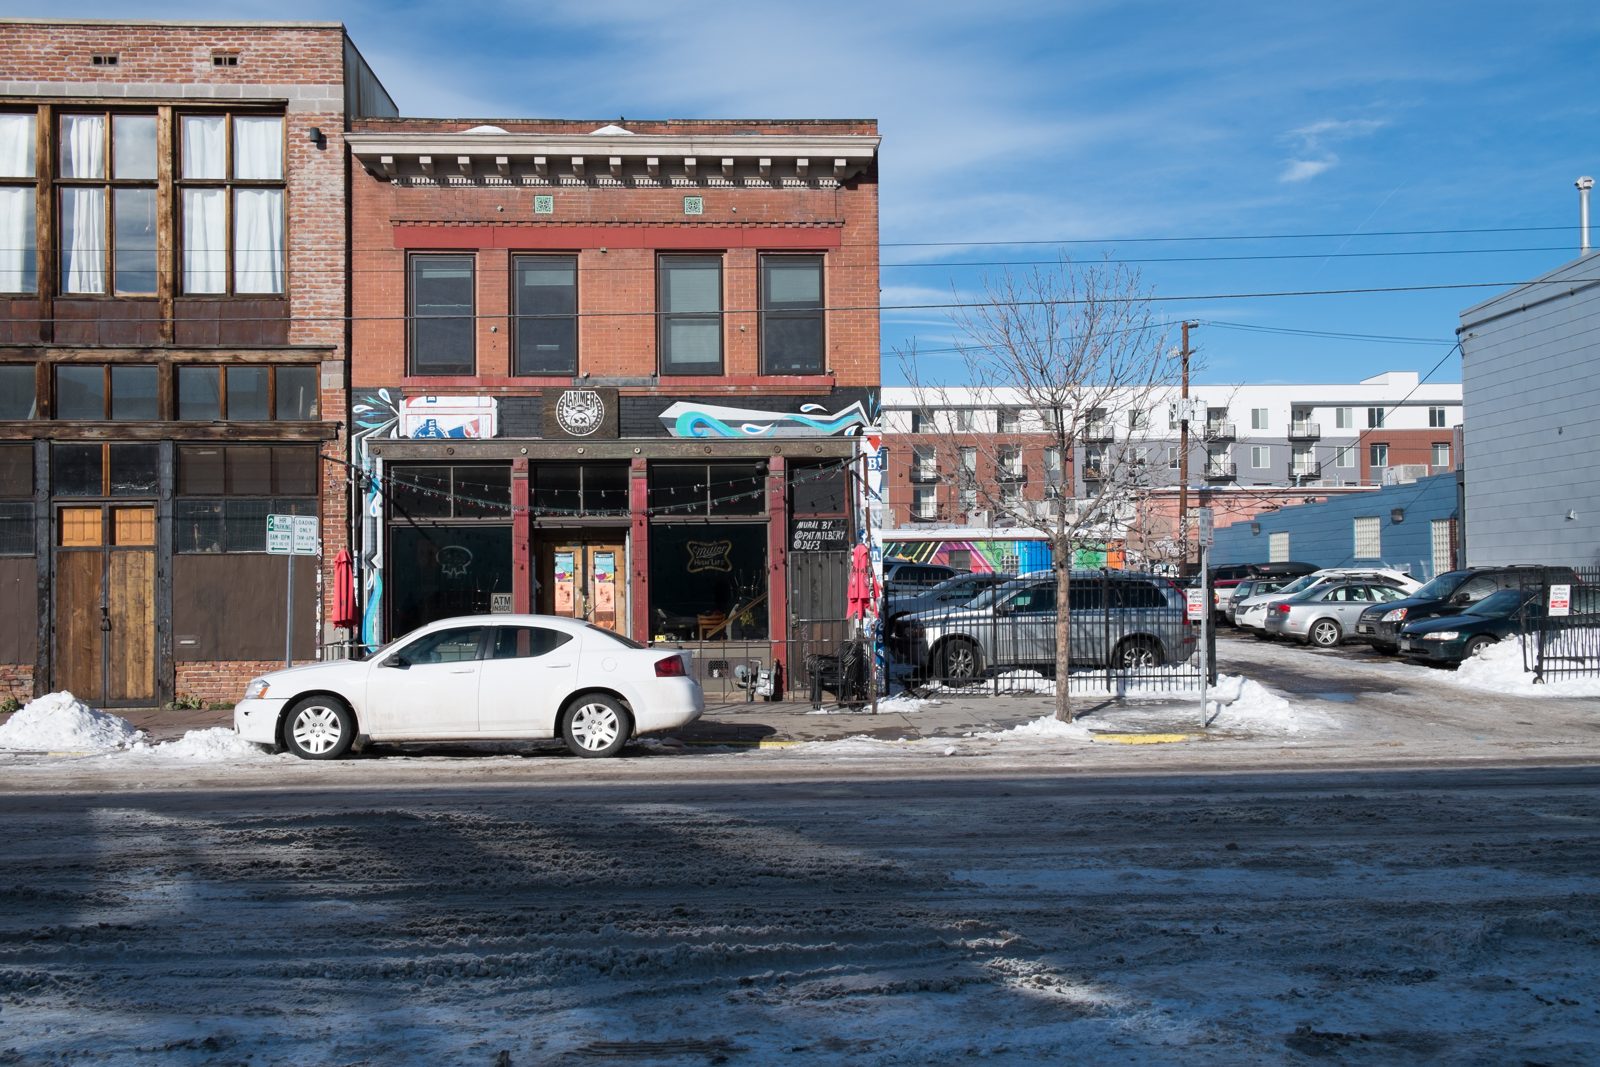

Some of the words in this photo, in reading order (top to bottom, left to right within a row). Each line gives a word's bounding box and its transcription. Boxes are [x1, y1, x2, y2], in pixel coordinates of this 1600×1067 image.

[565, 391, 595, 408] LARIMER
[269, 518, 274, 529] 2
[796, 521, 819, 529] MURAL
[821, 521, 832, 529] BY
[793, 540, 821, 550] @DEF3
[692, 543, 728, 558] Miller
[494, 597, 510, 605] ATM
